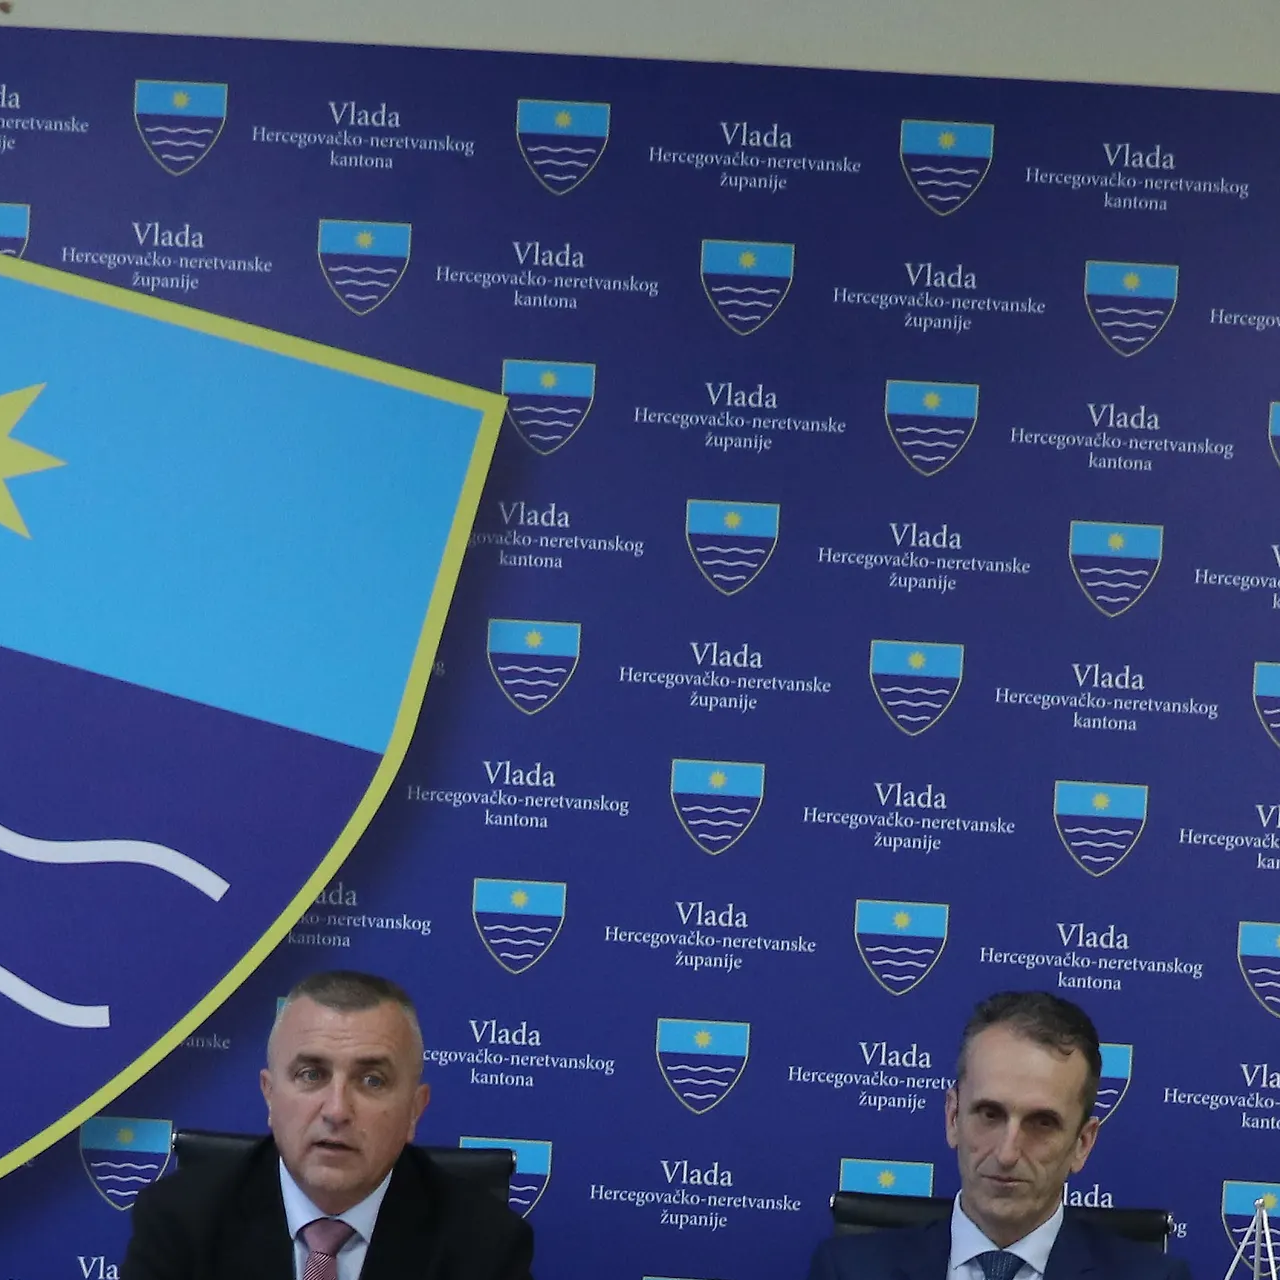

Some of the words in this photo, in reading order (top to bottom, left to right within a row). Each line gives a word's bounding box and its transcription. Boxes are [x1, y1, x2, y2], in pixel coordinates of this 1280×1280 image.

[328, 100, 401, 128] Vlada
[252, 125, 474, 157] Hercegovačko-neretvanskog
[720, 121, 793, 149] Vlada
[329, 148, 393, 169] kantona
[650, 146, 861, 173] Hercegovačko-neretvanske
[1102, 142, 1175, 170] Vlada
[720, 170, 787, 194] županije
[1026, 167, 1248, 199] Hercegovačko-neretvanskog
[1103, 190, 1167, 211] kantona
[132, 221, 205, 249] Vlada
[62, 246, 273, 273] Hercegovačko-neretvanske
[512, 241, 585, 269] Vlada
[132, 270, 199, 294] županije
[436, 266, 658, 298] Hercegovačko-neretvanskog
[904, 262, 977, 290] Vlada
[513, 289, 577, 310] kantona
[834, 287, 1045, 314] Hercegovačko-neretvanske
[904, 311, 971, 335] županije
[705, 381, 778, 409] Vlada
[635, 406, 846, 433] Hercegovačko-neretvanske
[1087, 403, 1160, 431] Vlada
[705, 430, 772, 454] županije
[1011, 428, 1233, 460] Hercegovačko-neretvanskog
[1088, 451, 1152, 472] kantona
[498, 500, 571, 528] Vlada
[469, 529, 644, 557] govačko-neretvanskog
[889, 522, 962, 550] Vlada
[499, 548, 563, 569] kantona
[819, 547, 1030, 574] Hercegovačko-neretvanske
[889, 571, 956, 595] županije
[690, 641, 763, 669] Vlada
[620, 666, 831, 693] Hercegovačko-neretvanske
[1072, 663, 1145, 691] Vlada
[690, 690, 757, 714] županije
[996, 688, 1218, 720] Hercegovačko-neretvanskog
[1073, 711, 1137, 732] kantona
[483, 760, 556, 788] Vlada
[407, 785, 629, 817] Hercegovačko-neretvanskog
[874, 782, 947, 810] Vlada
[484, 808, 548, 829] kantona
[804, 807, 1015, 834] Hercegovačko-neretvanske
[874, 831, 941, 855] županije
[315, 883, 358, 907] ada
[675, 901, 748, 929] Vlada
[605, 926, 816, 953] Hercegovačko-neretvanske
[1057, 922, 1130, 950] Vlada
[675, 950, 742, 974] županije
[981, 947, 1203, 979] Hercegovačko-neretvanskog
[1058, 970, 1122, 991] kantona
[469, 1019, 542, 1047] Vlada
[423, 1046, 615, 1076] cegovačko-neretvanskog
[859, 1041, 932, 1069] Vlada
[470, 1067, 534, 1088] kantona
[788, 1066, 956, 1091] Hercegovačko-neretv
[859, 1090, 926, 1114] županije
[661, 1159, 734, 1187] Vlada
[591, 1184, 802, 1211] Hercegovačko-neretvanske
[1063, 1182, 1113, 1209] lada
[661, 1208, 728, 1232] županije
[77, 1255, 120, 1280] Vla
